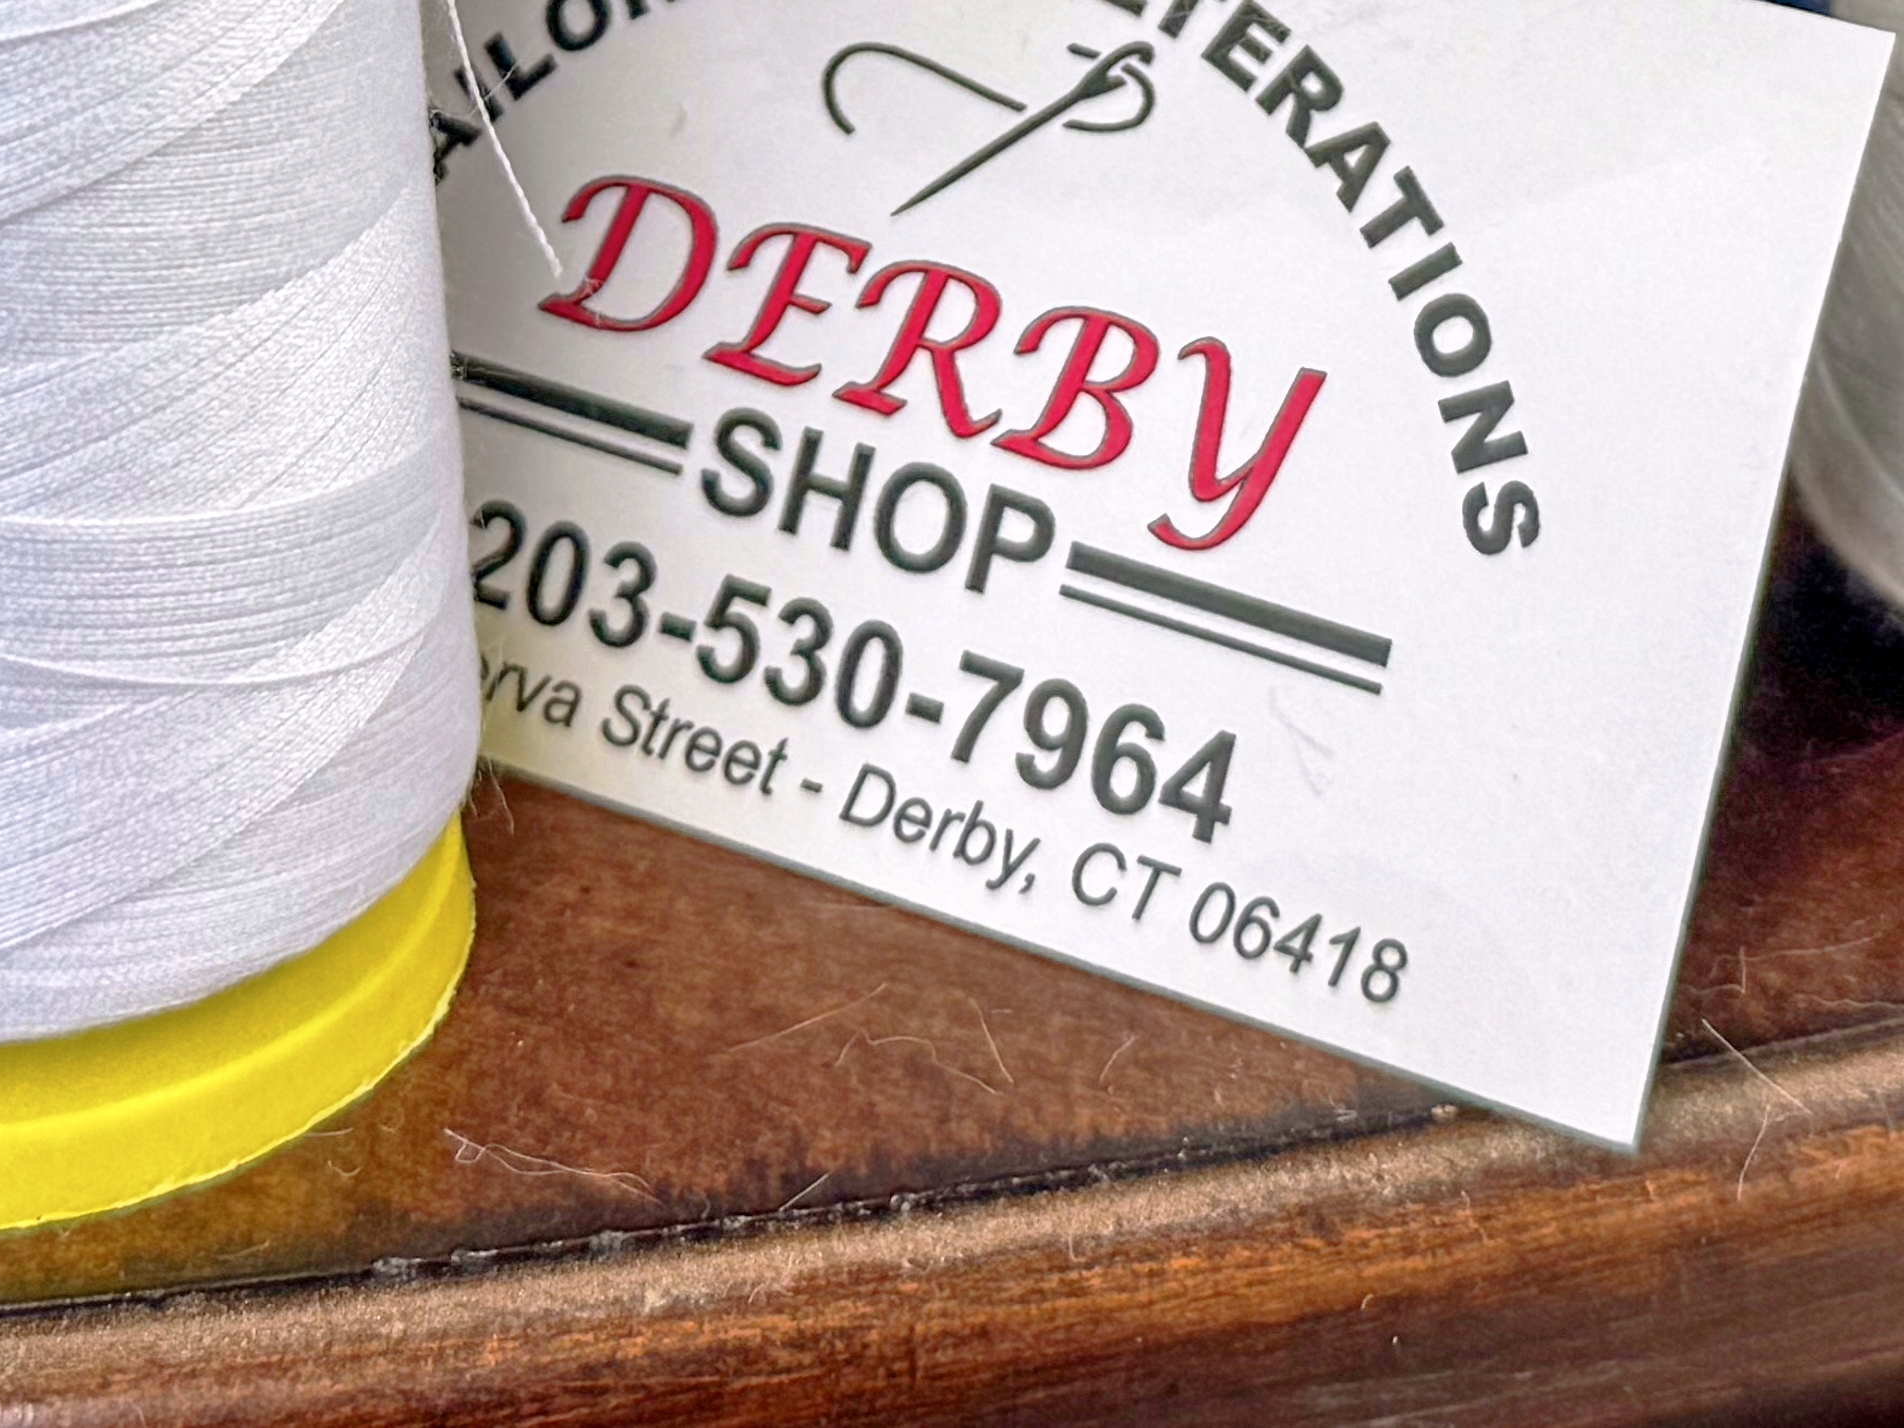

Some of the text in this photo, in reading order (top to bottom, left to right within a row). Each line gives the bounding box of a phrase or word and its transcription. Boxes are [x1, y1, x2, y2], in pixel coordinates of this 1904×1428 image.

[536, 172, 1328, 553] DERBY
[700, 407, 1056, 595] SHOP
[471, 498, 1237, 845] 203-530-7964
[480, 652, 583, 730] rva
[600, 684, 789, 796] Street
[839, 765, 1042, 893] Derby,
[1072, 844, 1183, 921] CT
[1189, 883, 1408, 1004] 06418
